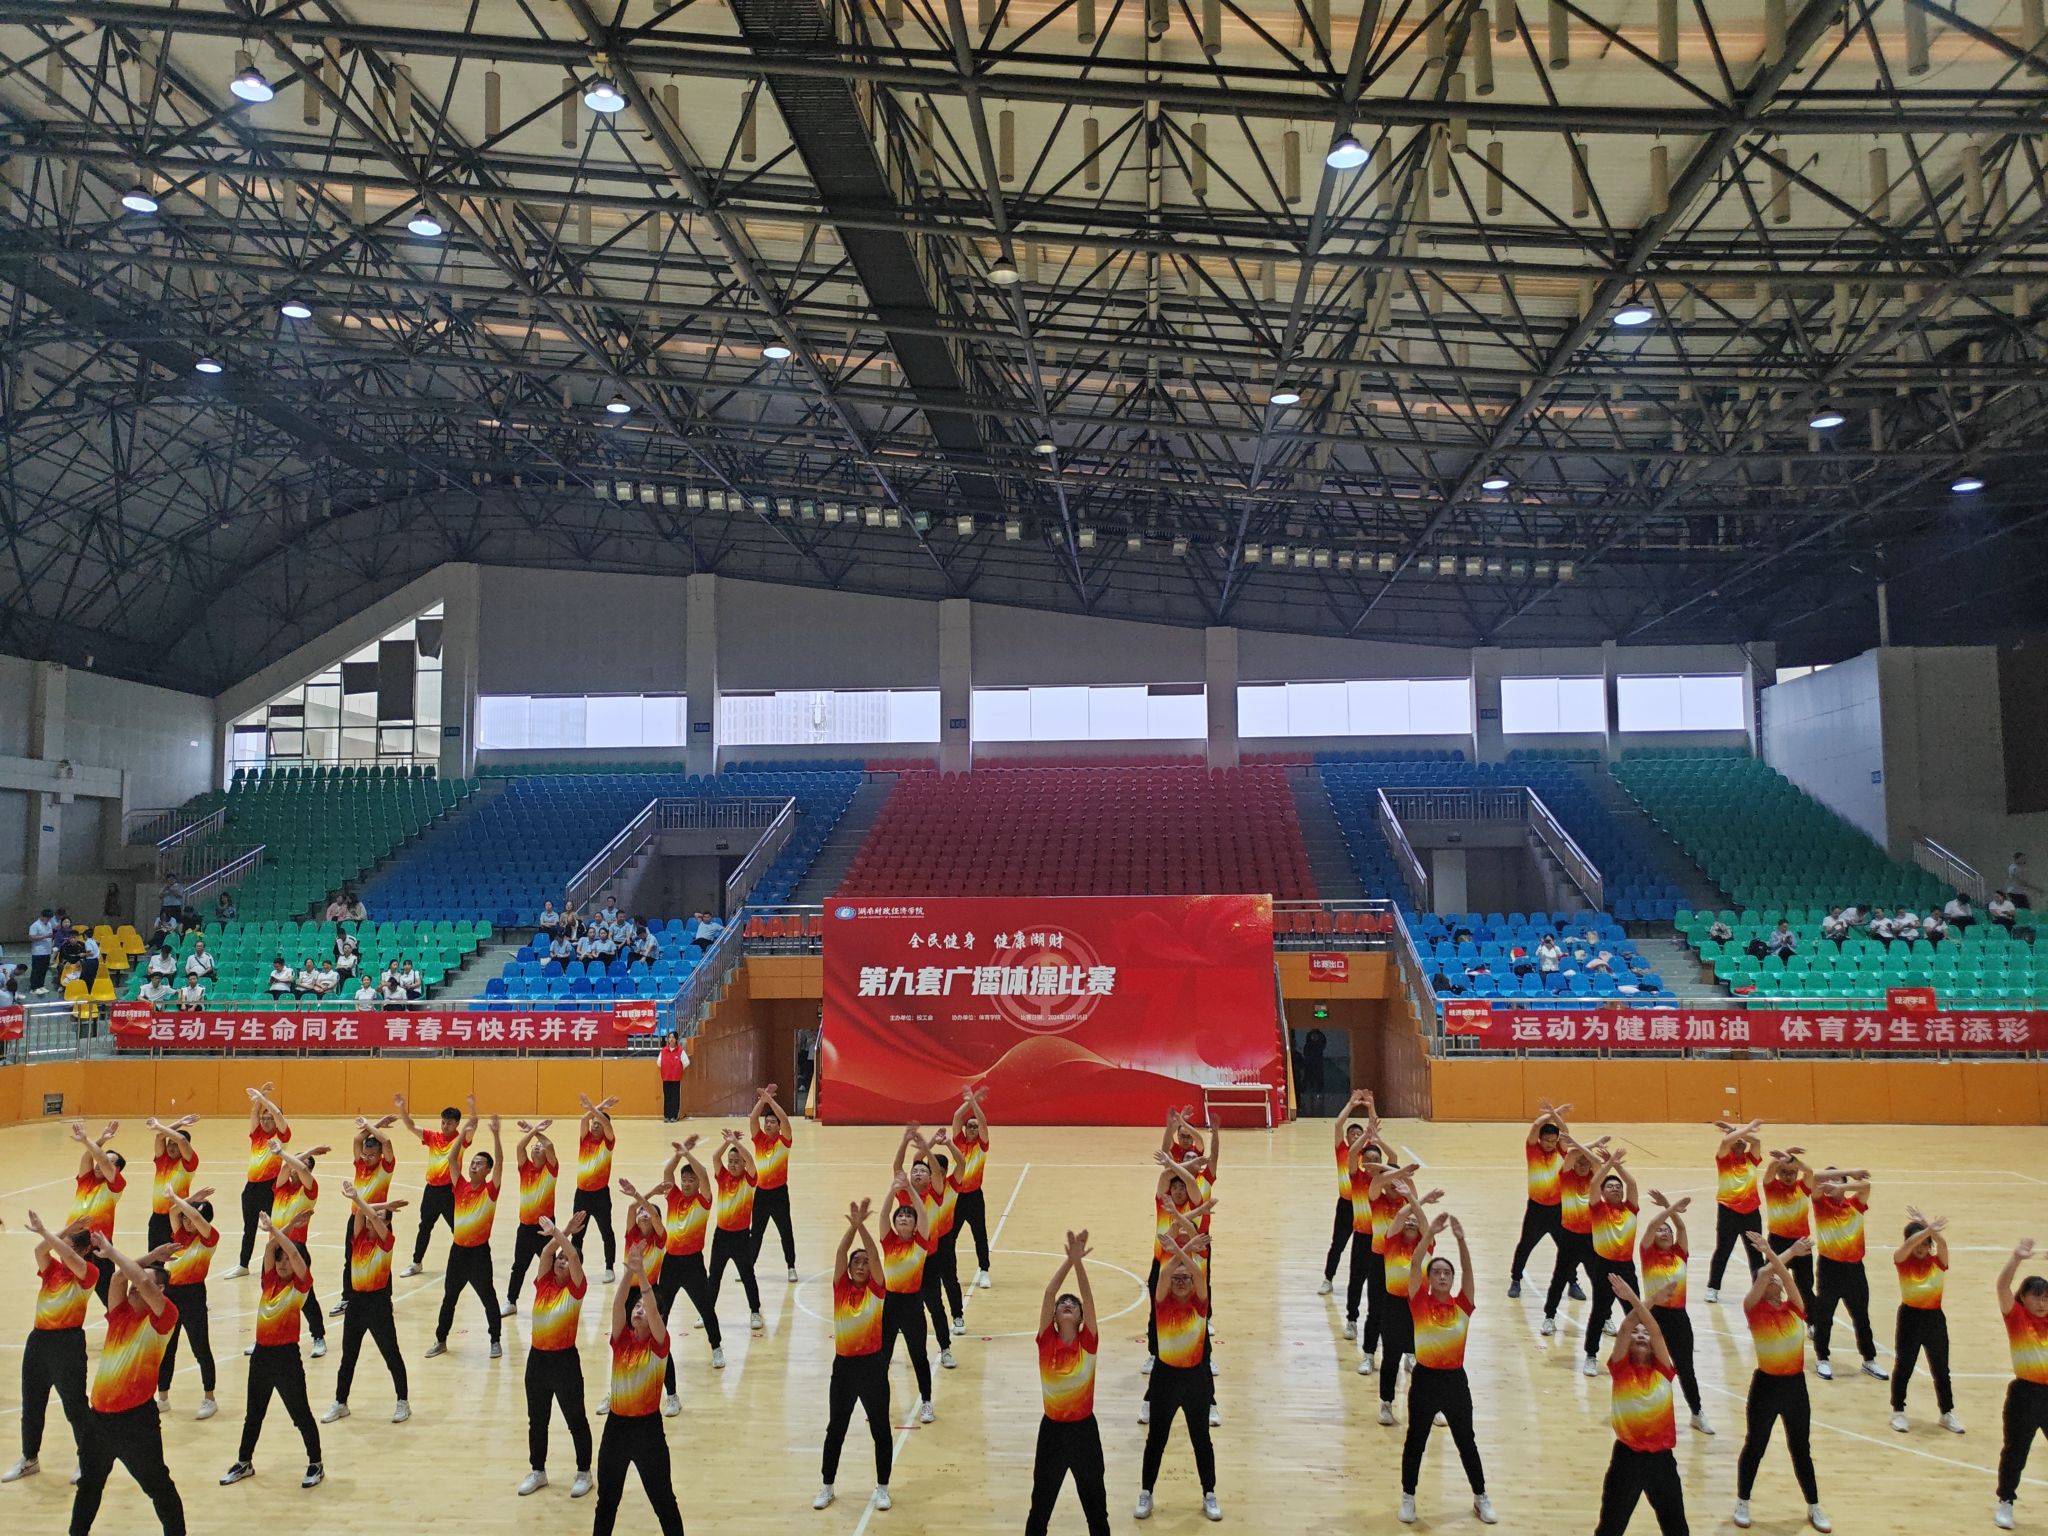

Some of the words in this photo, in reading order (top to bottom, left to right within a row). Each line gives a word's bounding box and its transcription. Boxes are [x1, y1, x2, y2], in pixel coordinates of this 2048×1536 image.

[858, 907, 925, 916] 湖南财政经济学院
[908, 932, 976, 950] 全民健身
[994, 931, 1064, 950] 健康湖财
[1313, 960, 1345, 968] 比赛出口
[857, 966, 1117, 997] 第九套广播体操比赛
[148, 1017, 359, 1042] 运动与生命同在
[384, 1017, 599, 1042] 青春与快乐并存
[1511, 1015, 1750, 1041] 运动为健康加油
[1779, 1015, 2030, 1043] 体育为生活添彩
